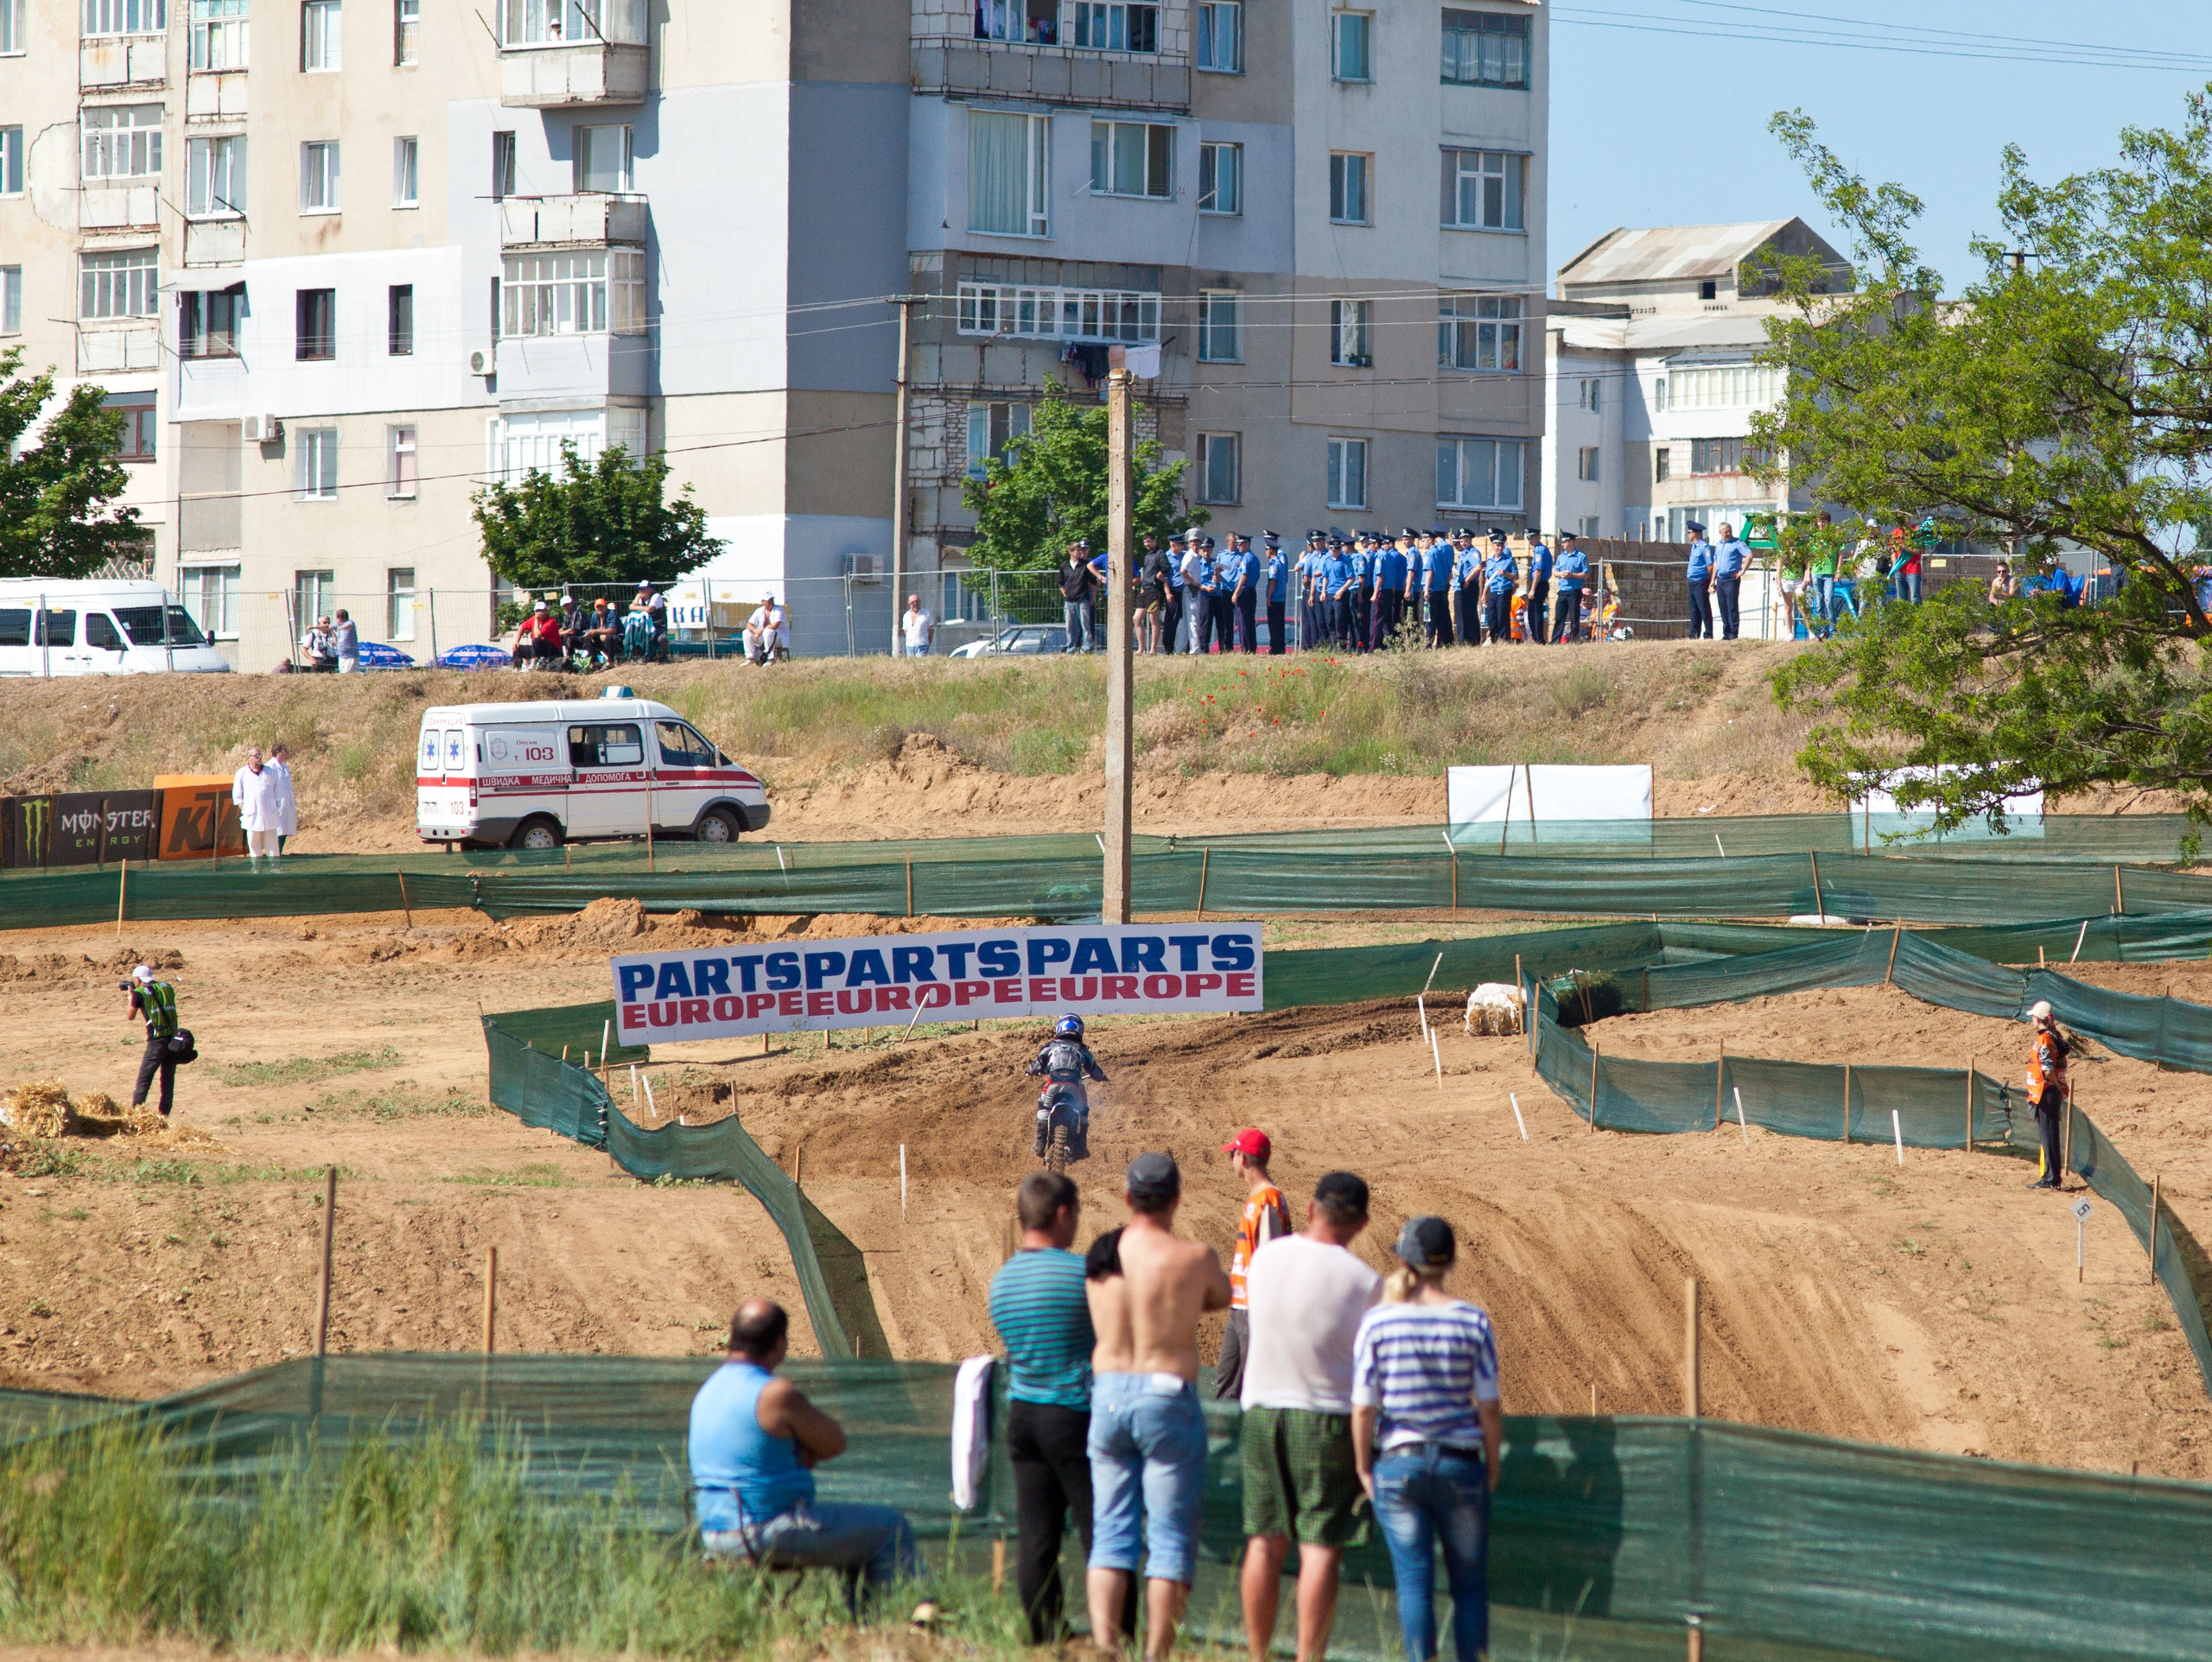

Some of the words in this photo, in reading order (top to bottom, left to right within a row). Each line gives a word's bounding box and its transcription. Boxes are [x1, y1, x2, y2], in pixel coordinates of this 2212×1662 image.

[525, 747, 554, 761] 103
[482, 777, 521, 787] ШВИДКА
[531, 774, 572, 785] МЕДИЧНА
[585, 772, 632, 783] ДОПОМОГА
[450, 801, 465, 815] 103
[75, 834, 141, 847] ENRGY
[619, 952, 802, 1003] PARTS
[804, 940, 1021, 990] PARTS
[1027, 934, 1255, 975] PARTS
[622, 991, 804, 1030] EUROPE
[806, 979, 1023, 1017] EUROPE
[1028, 973, 1255, 1002] EUROPE
